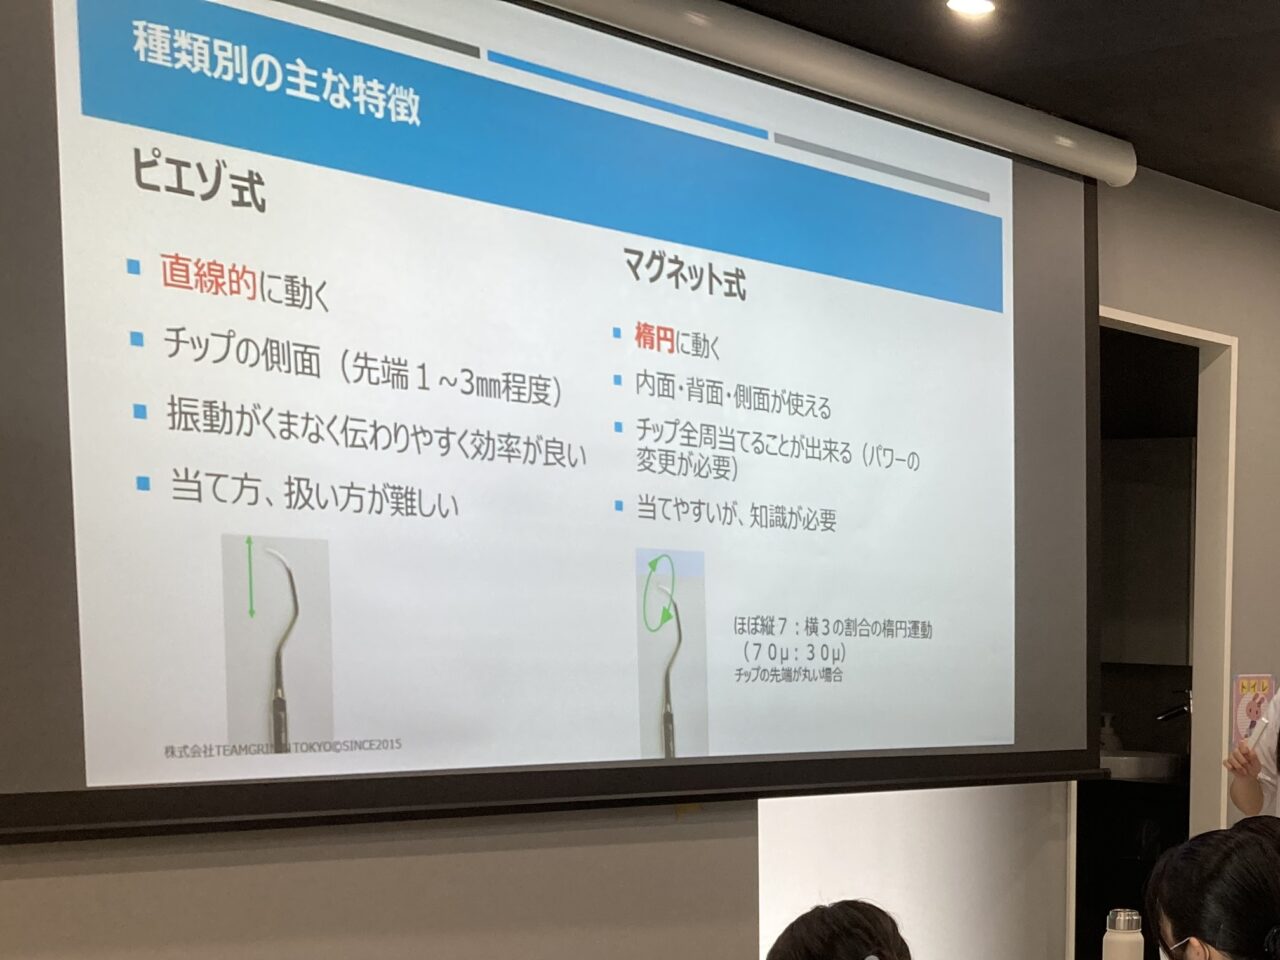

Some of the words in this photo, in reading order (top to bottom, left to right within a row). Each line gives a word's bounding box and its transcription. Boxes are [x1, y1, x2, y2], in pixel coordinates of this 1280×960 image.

[133, 19, 421, 127] 種類別の主な特徴
[133, 148, 266, 213] ピエゾ式
[160, 253, 330, 312] 直線的に動く
[623, 247, 746, 301] マグネット式
[634, 321, 720, 361] 楕円に動く
[636, 369, 831, 420] 内面・背面・側面が使える
[166, 395, 587, 468] 振動がくまなく伝わりやすく効率が良い
[636, 450, 738, 482] 変更が必要）
[171, 467, 459, 519] 当て方、扱い方が難しい
[637, 494, 837, 533] 当てやすいが、知識が必要
[734, 666, 844, 684] チップの先端が丸い場合
[1241, 681, 1269, 693] トイレ
